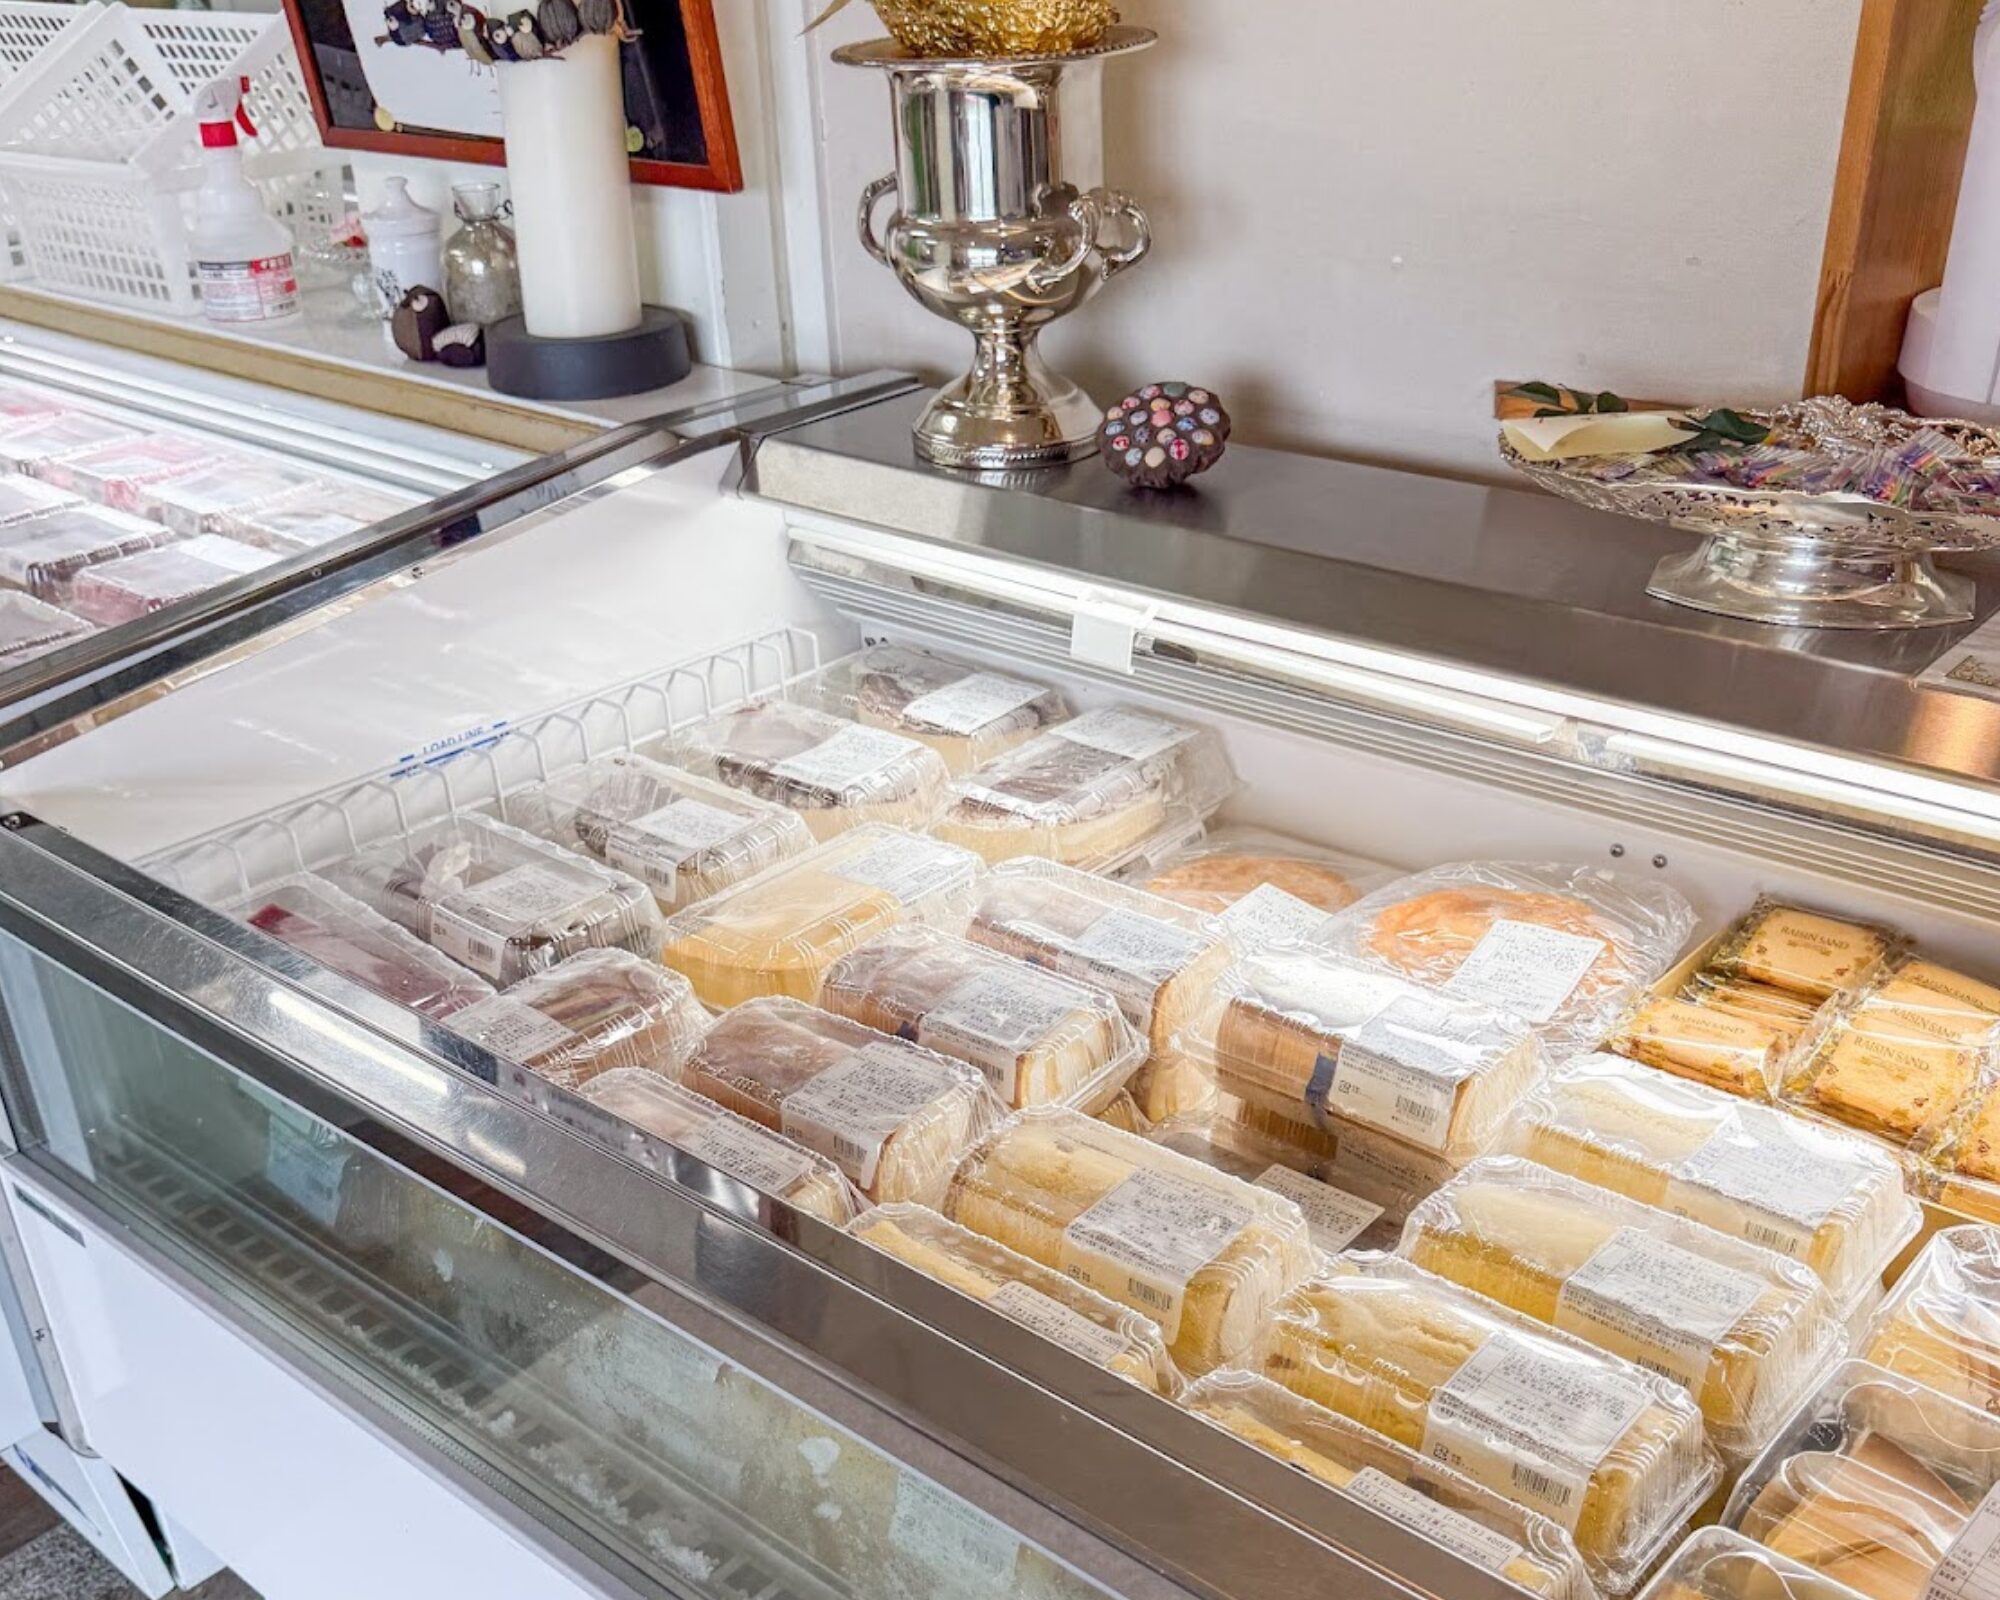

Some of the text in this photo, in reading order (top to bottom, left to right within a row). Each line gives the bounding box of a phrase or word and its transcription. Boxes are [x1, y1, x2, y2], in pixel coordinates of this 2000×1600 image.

[423, 737, 457, 755] LOAD
[1780, 926, 1850, 950] RAISIN SAND
[1889, 1008, 1930, 1029] RAISIN
[1854, 1035, 1930, 1072] RAISIN SAND
